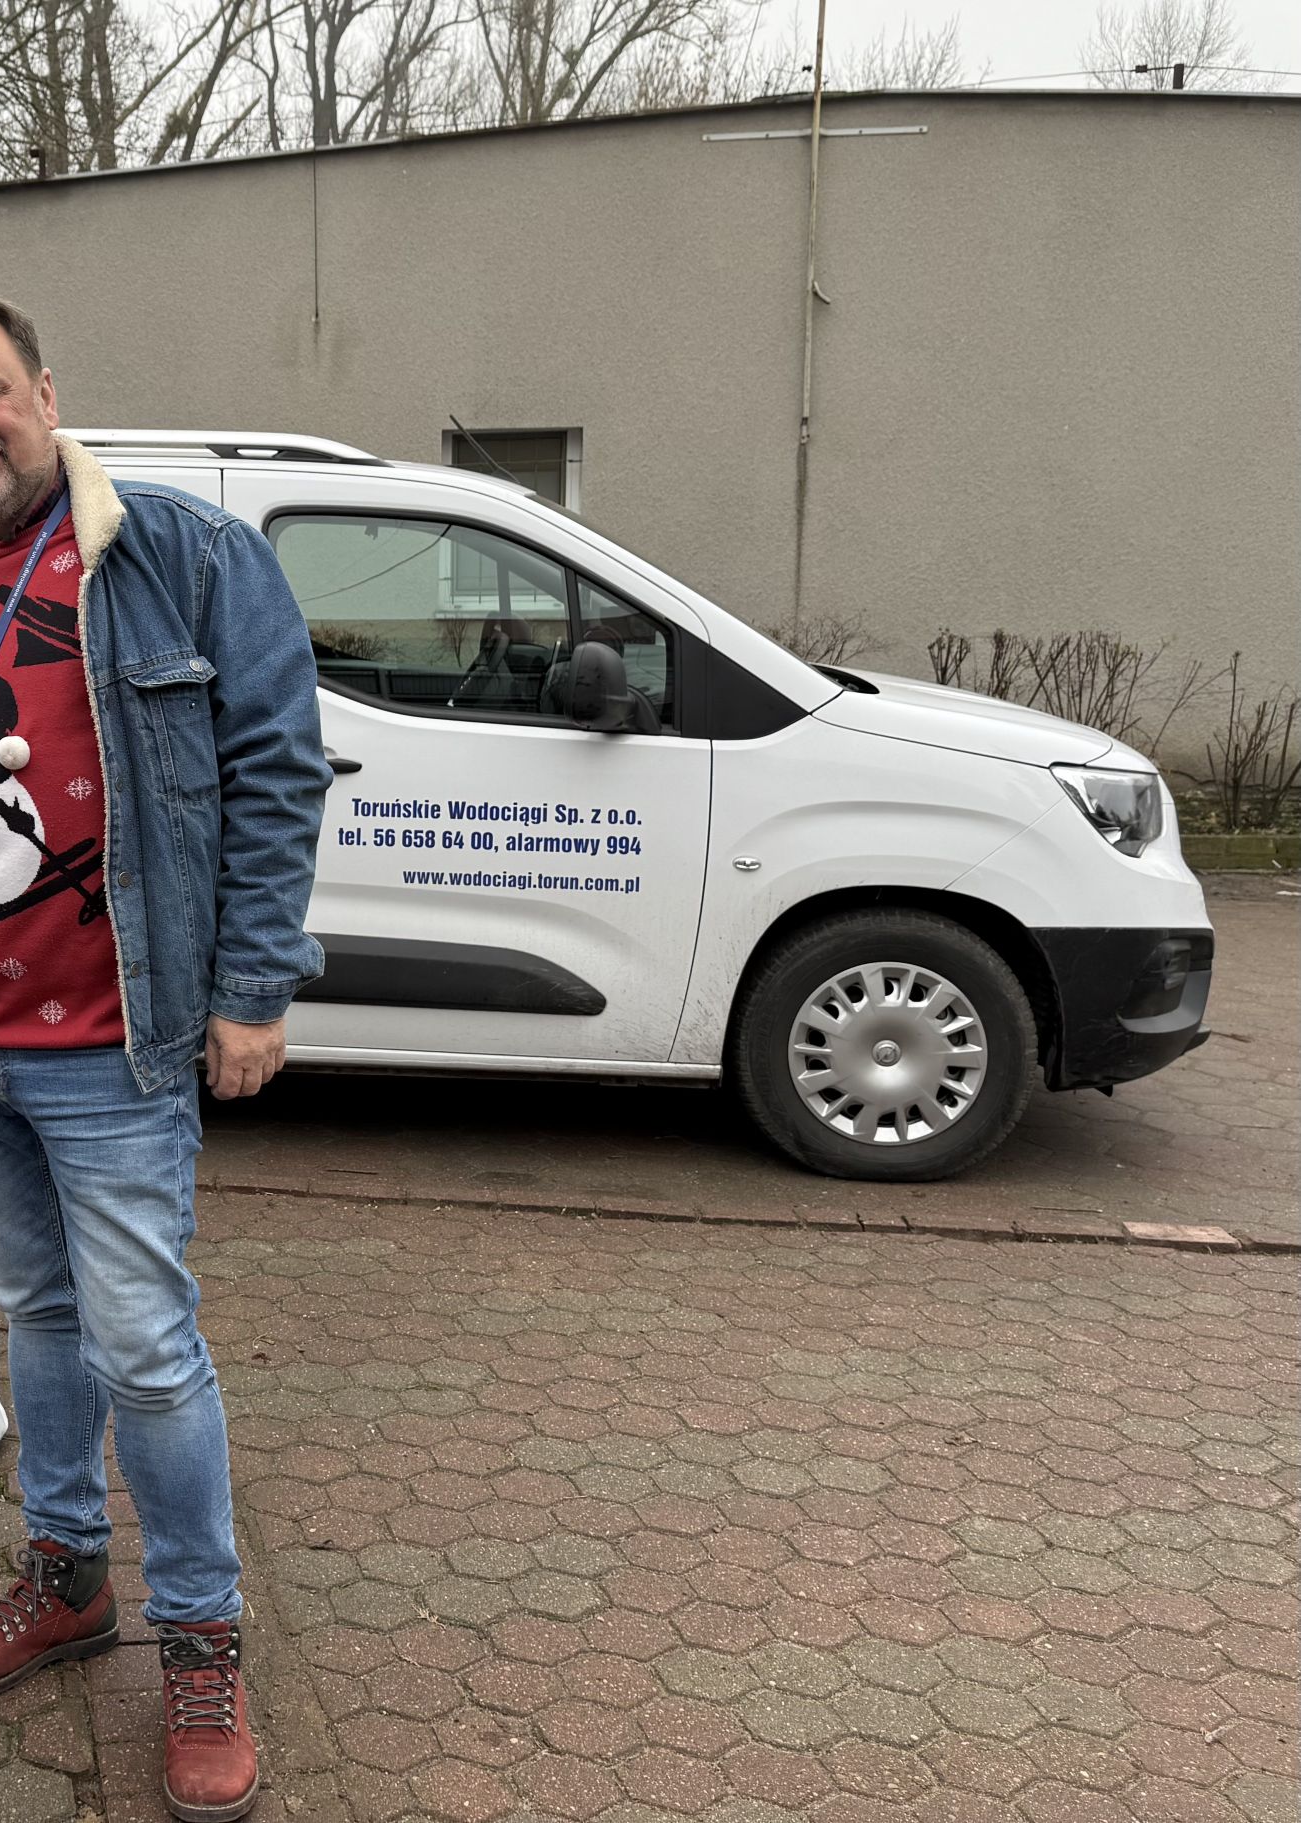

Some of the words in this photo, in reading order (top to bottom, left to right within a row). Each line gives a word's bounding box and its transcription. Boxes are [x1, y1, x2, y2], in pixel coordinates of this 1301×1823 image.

[352, 798, 441, 819] Toruńskie
[448, 801, 548, 827] Wodociągi
[554, 804, 585, 825] Sp.
[591, 808, 601, 824] z
[607, 808, 642, 826] o.o.
[338, 827, 367, 847] tel.
[373, 828, 396, 847] 56
[401, 829, 436, 848] 658
[442, 830, 465, 850] 64
[470, 832, 499, 853] 00,
[506, 833, 600, 856] alarmowy
[606, 836, 642, 855] 994
[403, 870, 640, 894] www.wodociagi.torun.com.pl
